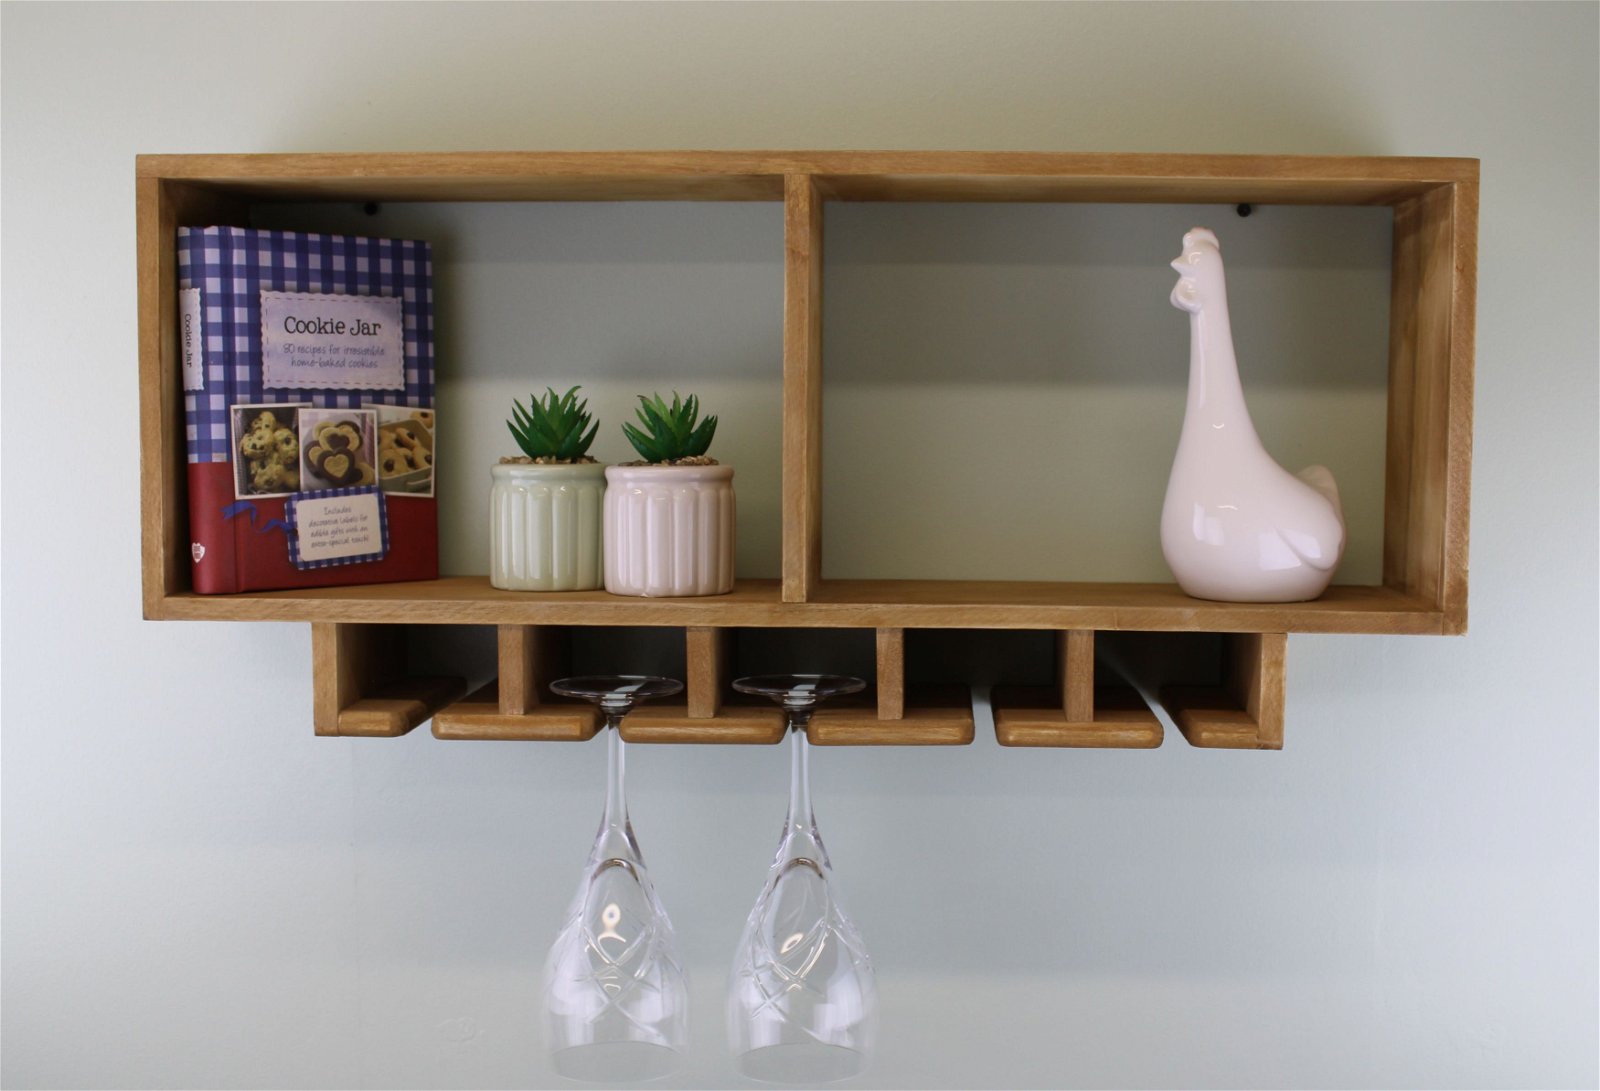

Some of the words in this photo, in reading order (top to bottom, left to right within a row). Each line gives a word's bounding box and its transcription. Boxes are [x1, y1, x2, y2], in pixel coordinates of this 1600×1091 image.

[184, 314, 192, 348] Cookie
[284, 316, 346, 334] Cookie
[350, 318, 382, 336] Jar
[283, 343, 295, 354] 80
[298, 345, 326, 357] recipes
[330, 344, 340, 354] for
[291, 358, 346, 368] home-baked
[348, 360, 379, 368] cookies
